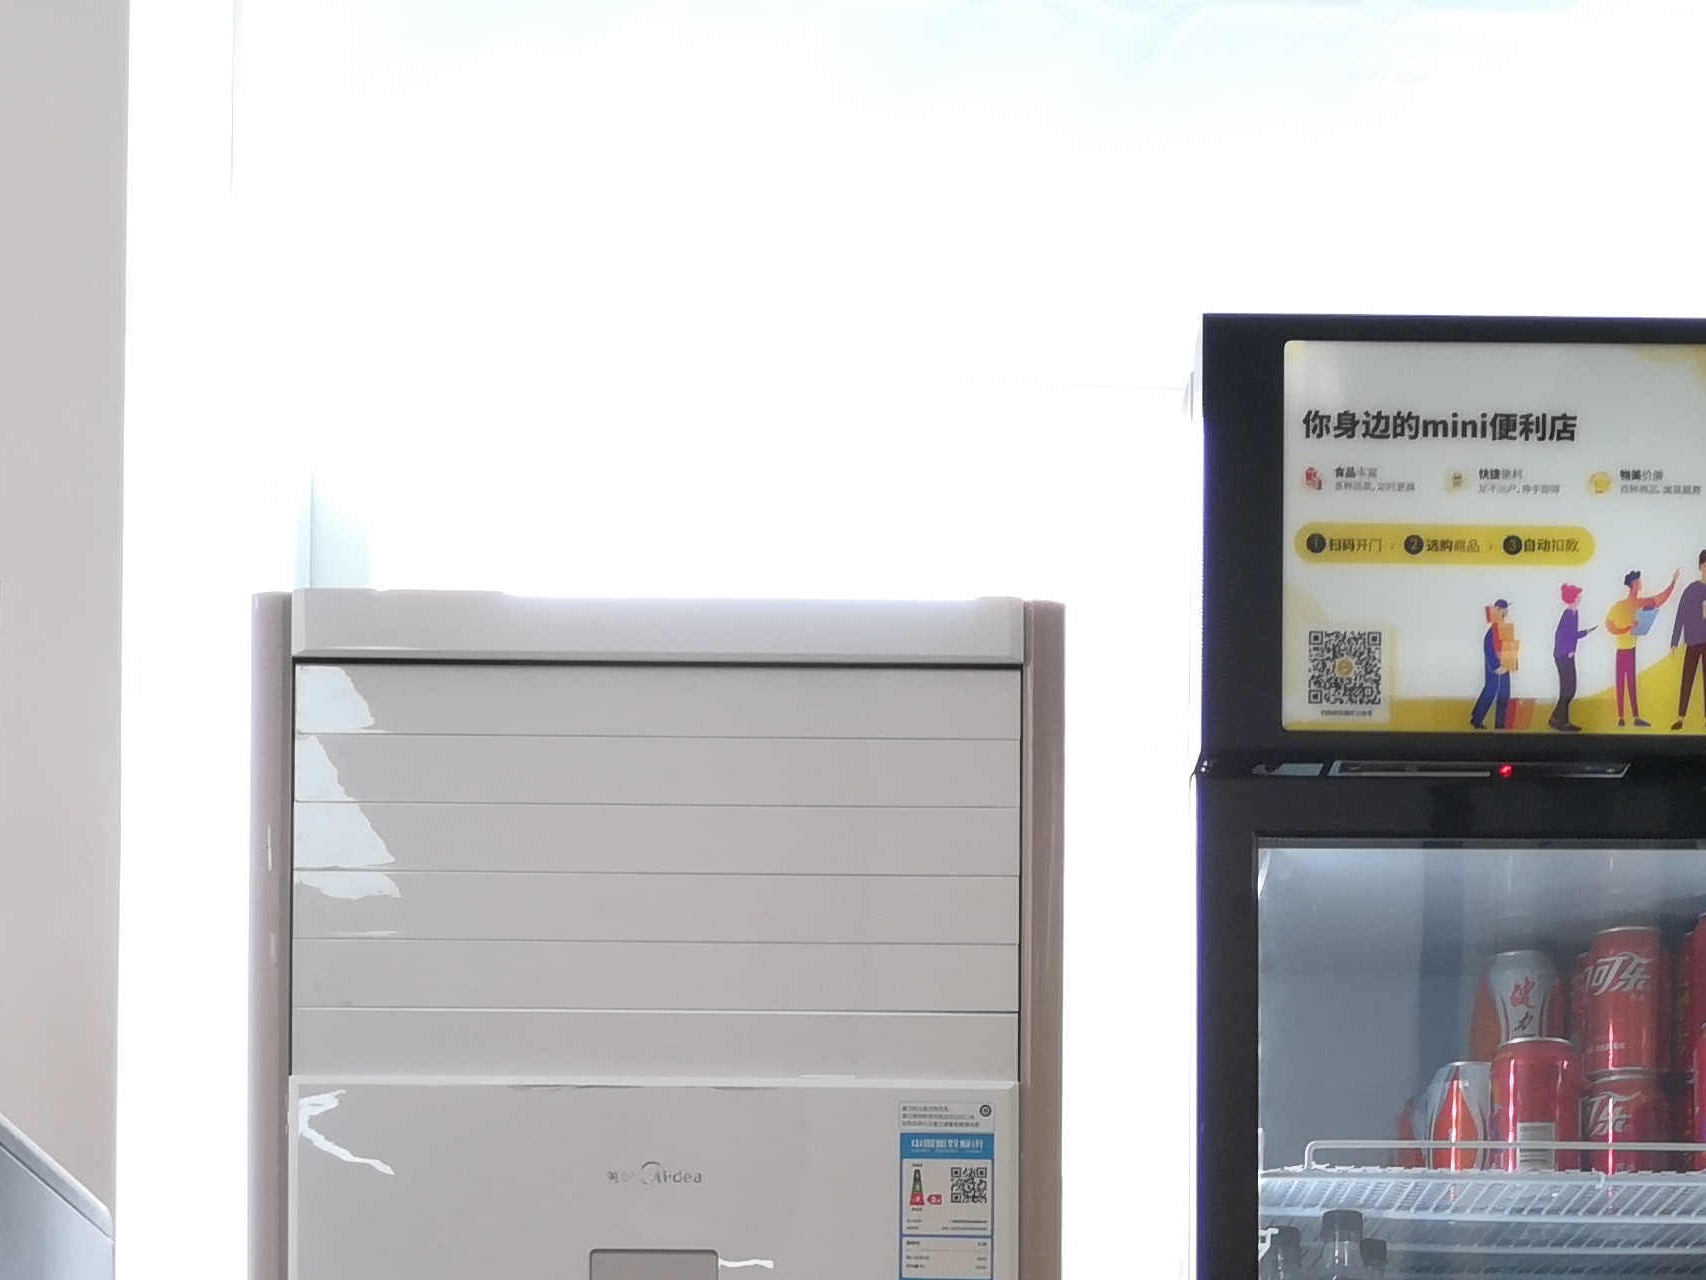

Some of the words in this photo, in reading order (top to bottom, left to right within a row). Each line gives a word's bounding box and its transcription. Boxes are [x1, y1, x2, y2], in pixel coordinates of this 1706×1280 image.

[1303, 410, 1578, 441] 你身边的mini便利店
[1329, 538, 1382, 551] 扫码开门
[1426, 538, 1480, 553] 选购商品
[1523, 538, 1579, 553] 自动扣款
